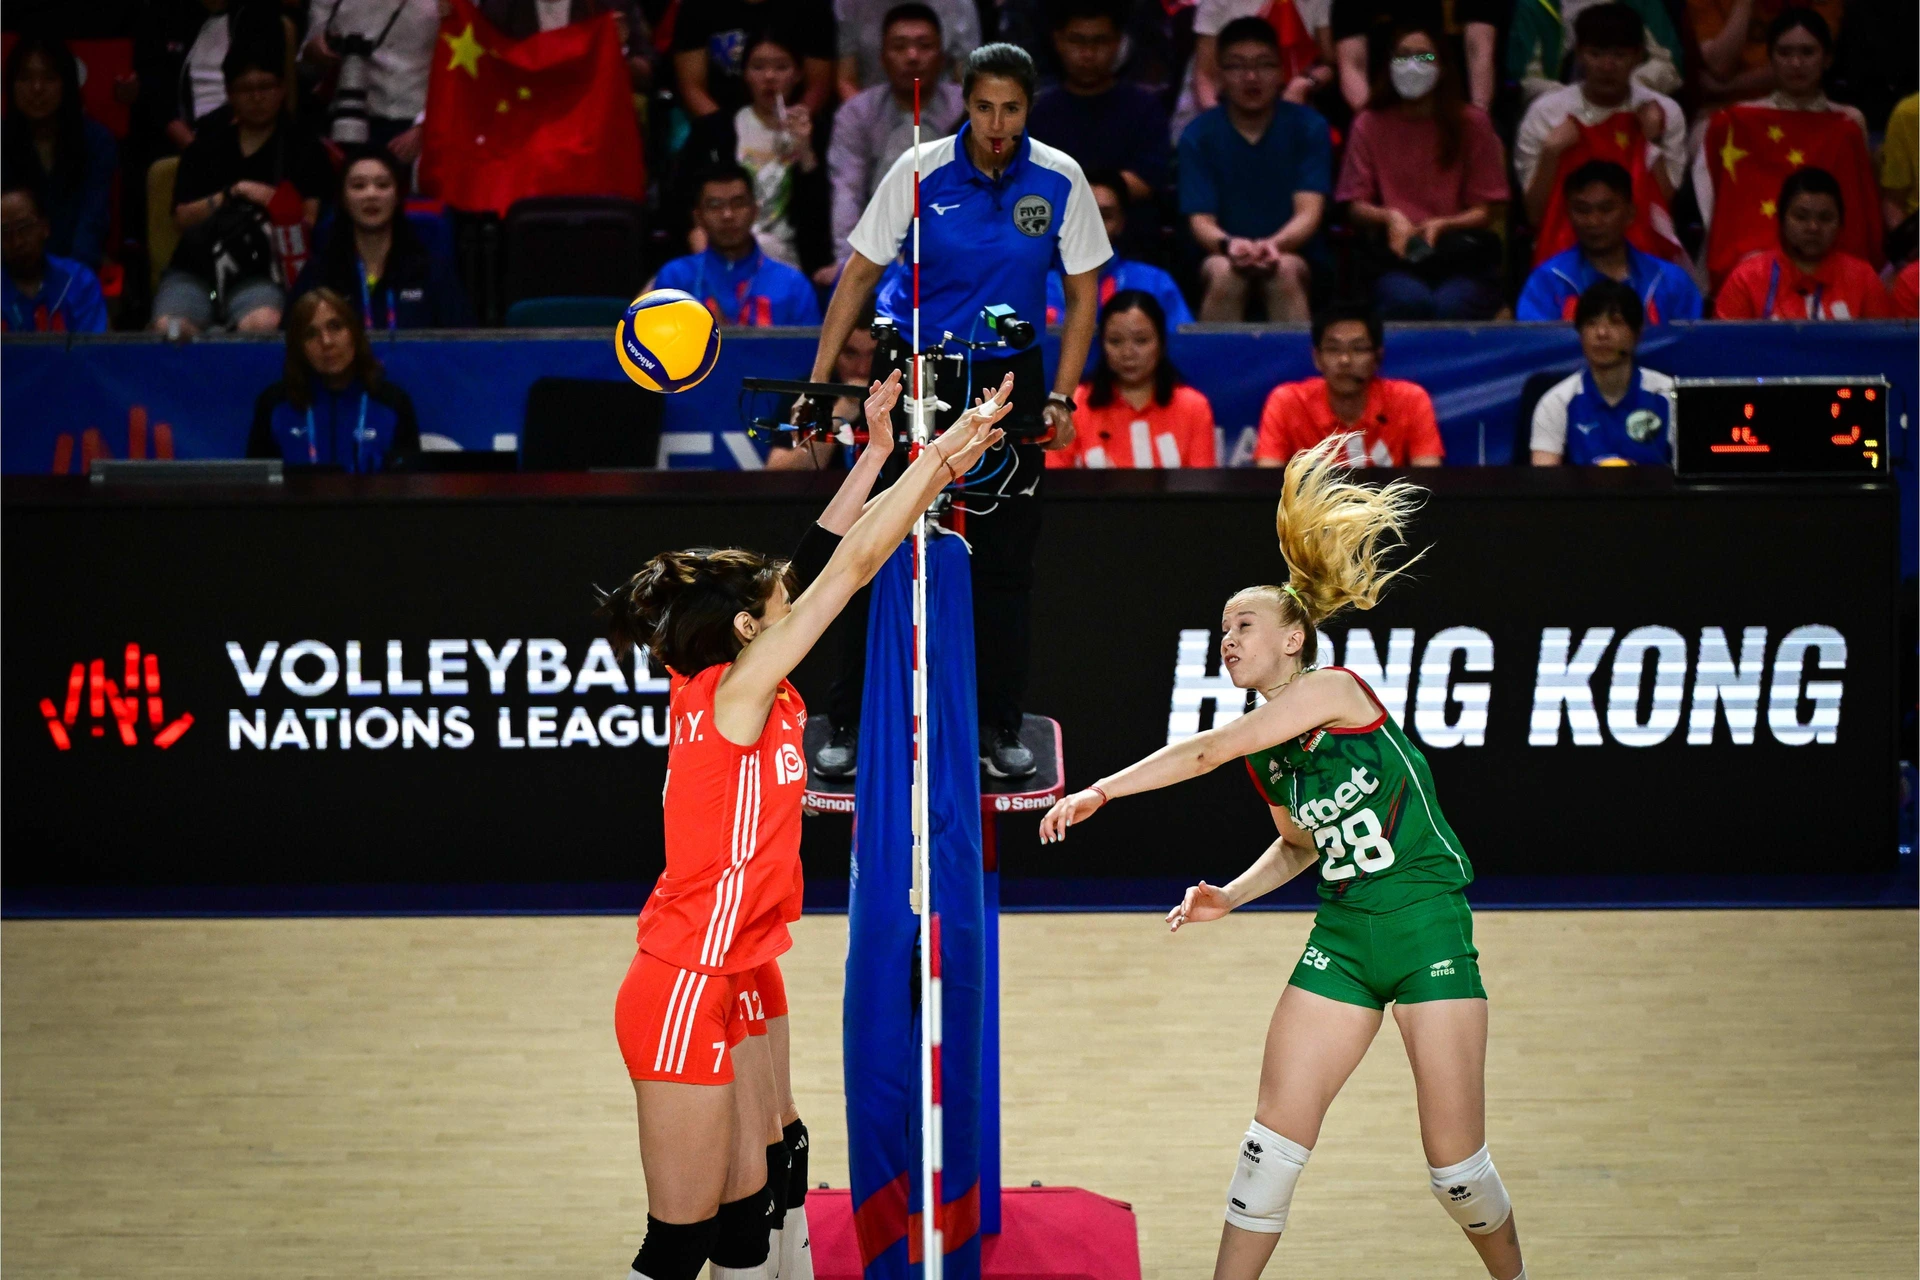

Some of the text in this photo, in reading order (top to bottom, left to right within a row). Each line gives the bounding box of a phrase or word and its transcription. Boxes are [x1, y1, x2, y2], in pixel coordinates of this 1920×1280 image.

[1020, 205, 1046, 217] FIVB
[226, 638, 671, 696] VOLLEYBAL
[1528, 623, 1847, 747] KONG
[228, 704, 671, 750] NATIONS LEAGU
[807, 794, 856, 812] Senoh
[1011, 793, 1056, 810] Senoh
[1313, 807, 1395, 882] 28
[1302, 945, 1331, 971] 28
[739, 990, 765, 1021] 12
[712, 1040, 726, 1074] 7
